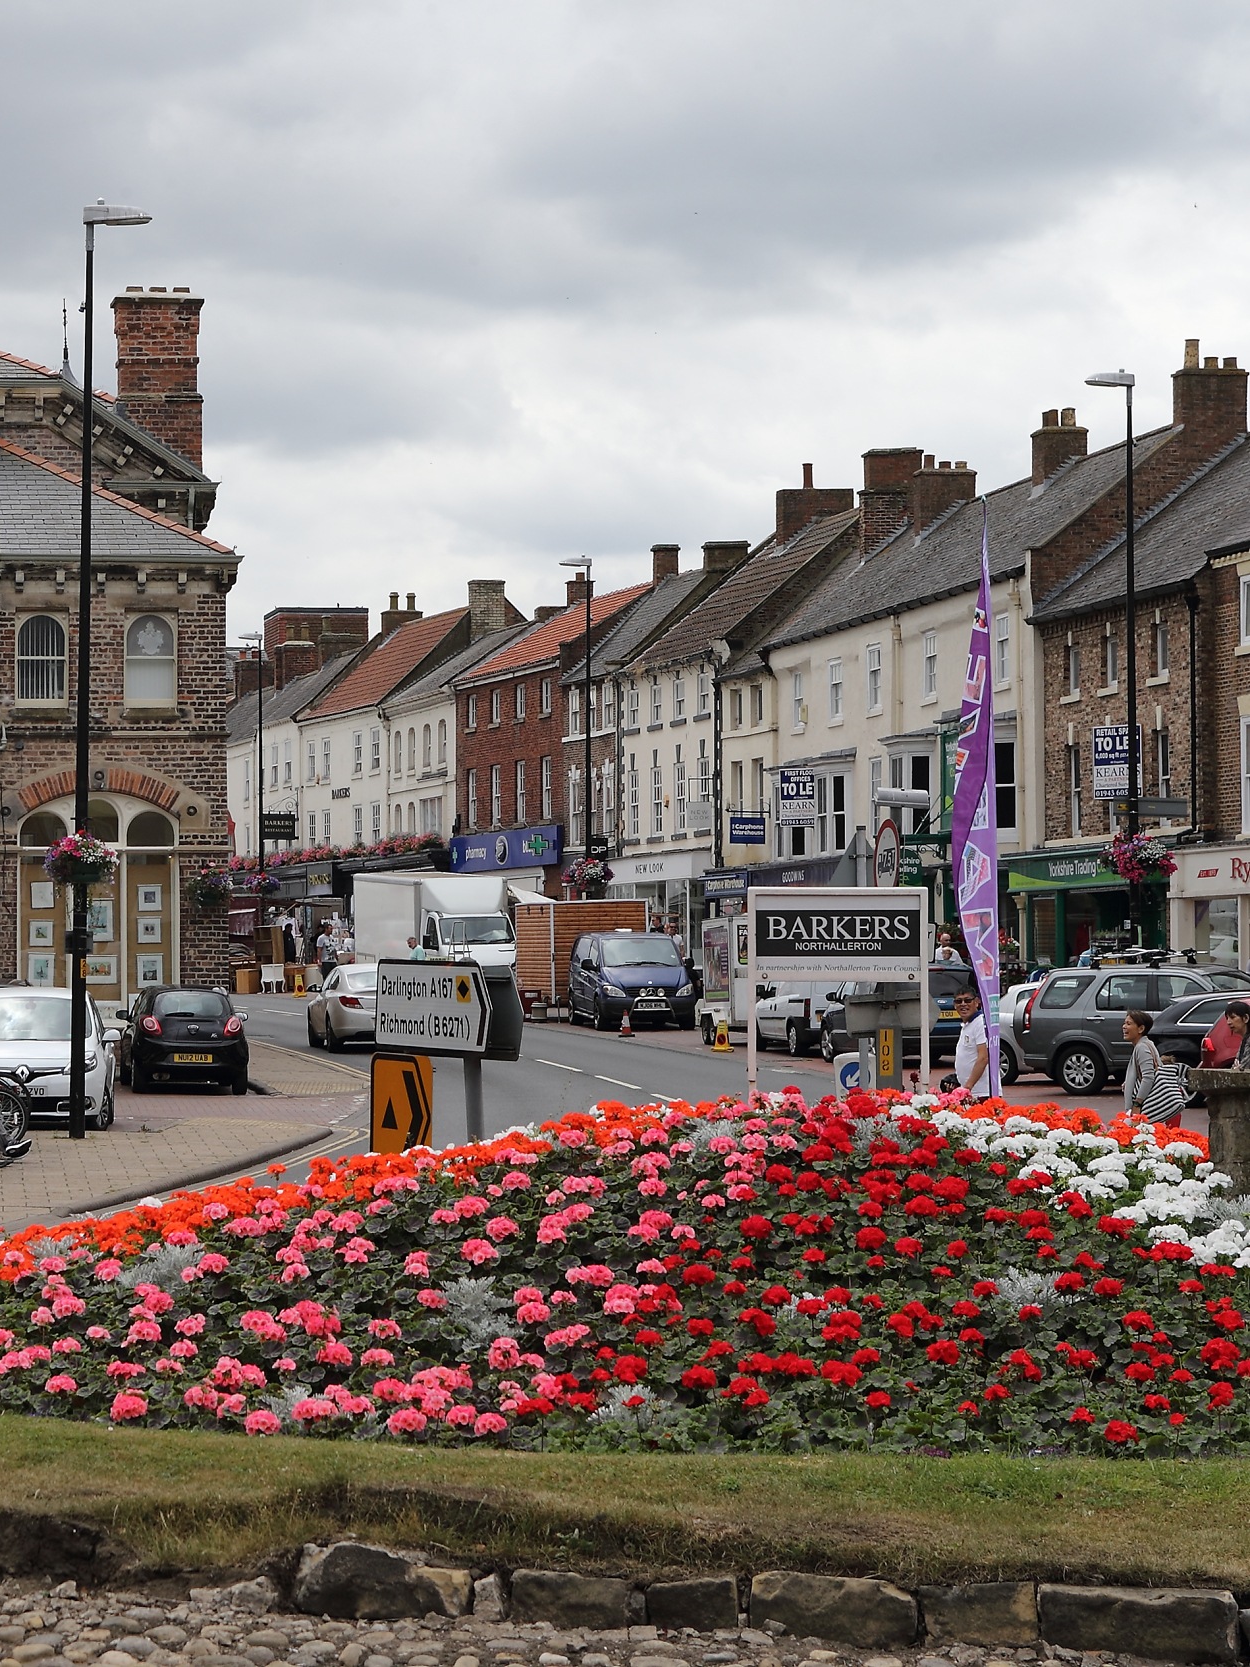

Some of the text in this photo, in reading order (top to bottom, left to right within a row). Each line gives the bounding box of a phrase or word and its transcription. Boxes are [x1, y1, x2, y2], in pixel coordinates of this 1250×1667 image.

[1096, 728, 1117, 737] RETAIL
[1095, 737, 1113, 751] TO
[331, 787, 350, 800] BARKERS
[781, 783, 797, 796] TO
[465, 846, 487, 862] pharmacy
[590, 845, 607, 854] DP
[635, 862, 665, 875] NEW LOOK
[1048, 861, 1073, 878] Yorkshire
[1073, 858, 1097, 875] Trading
[1230, 857, 1250, 883] Ry
[781, 870, 805, 883] GOODWINS
[707, 879, 745, 891] Carphone Warehouse
[766, 915, 911, 941] BARKERS
[795, 942, 882, 951] NORTHALLERTON
[381, 975, 453, 1000] Darlington A167
[380, 1013, 471, 1041] Richmond (B6271)
[195, 1054, 209, 1062] UAB
[28, 1087, 45, 1096] ZVO
